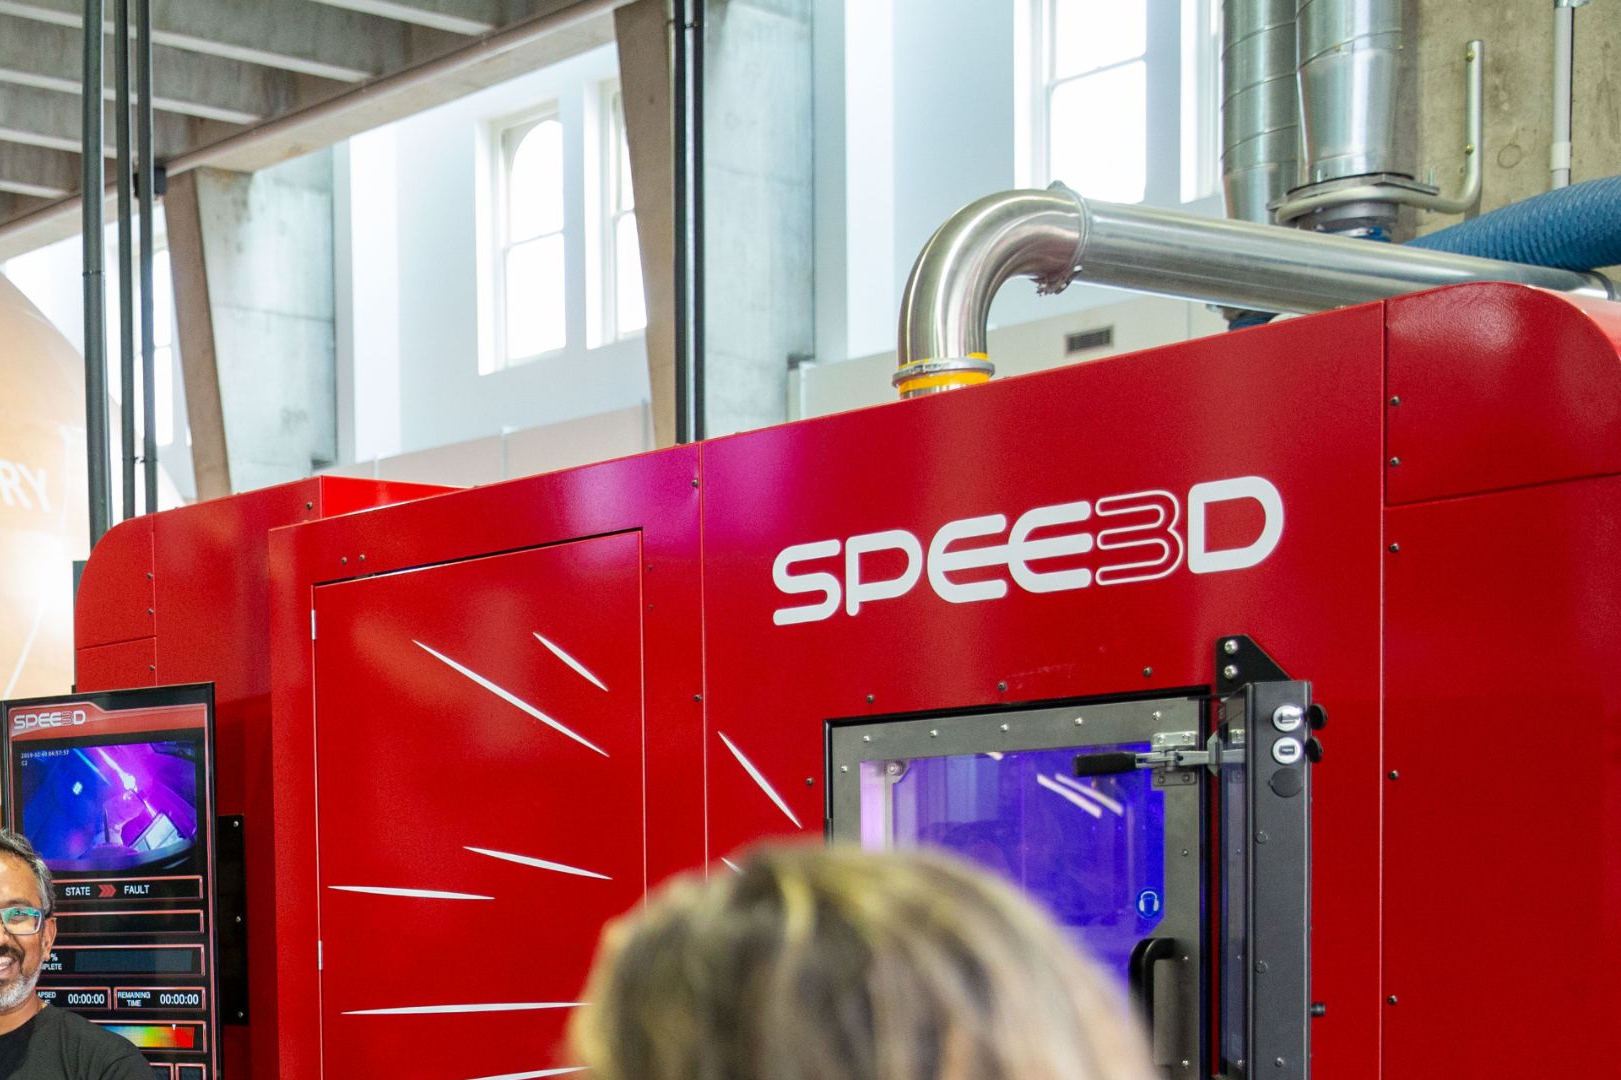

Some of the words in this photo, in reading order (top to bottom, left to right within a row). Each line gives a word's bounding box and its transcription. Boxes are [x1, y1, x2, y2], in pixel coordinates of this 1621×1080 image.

[772, 475, 1284, 626] SPEE3D
[13, 709, 87, 730] SPEE3D
[65, 886, 91, 896] STATE
[123, 884, 150, 894] FAULT
[67, 993, 105, 1005] 00:00:00
[117, 991, 151, 999] REMAINING
[159, 993, 199, 1005] 00:00:00
[127, 999, 142, 1007] TIME
